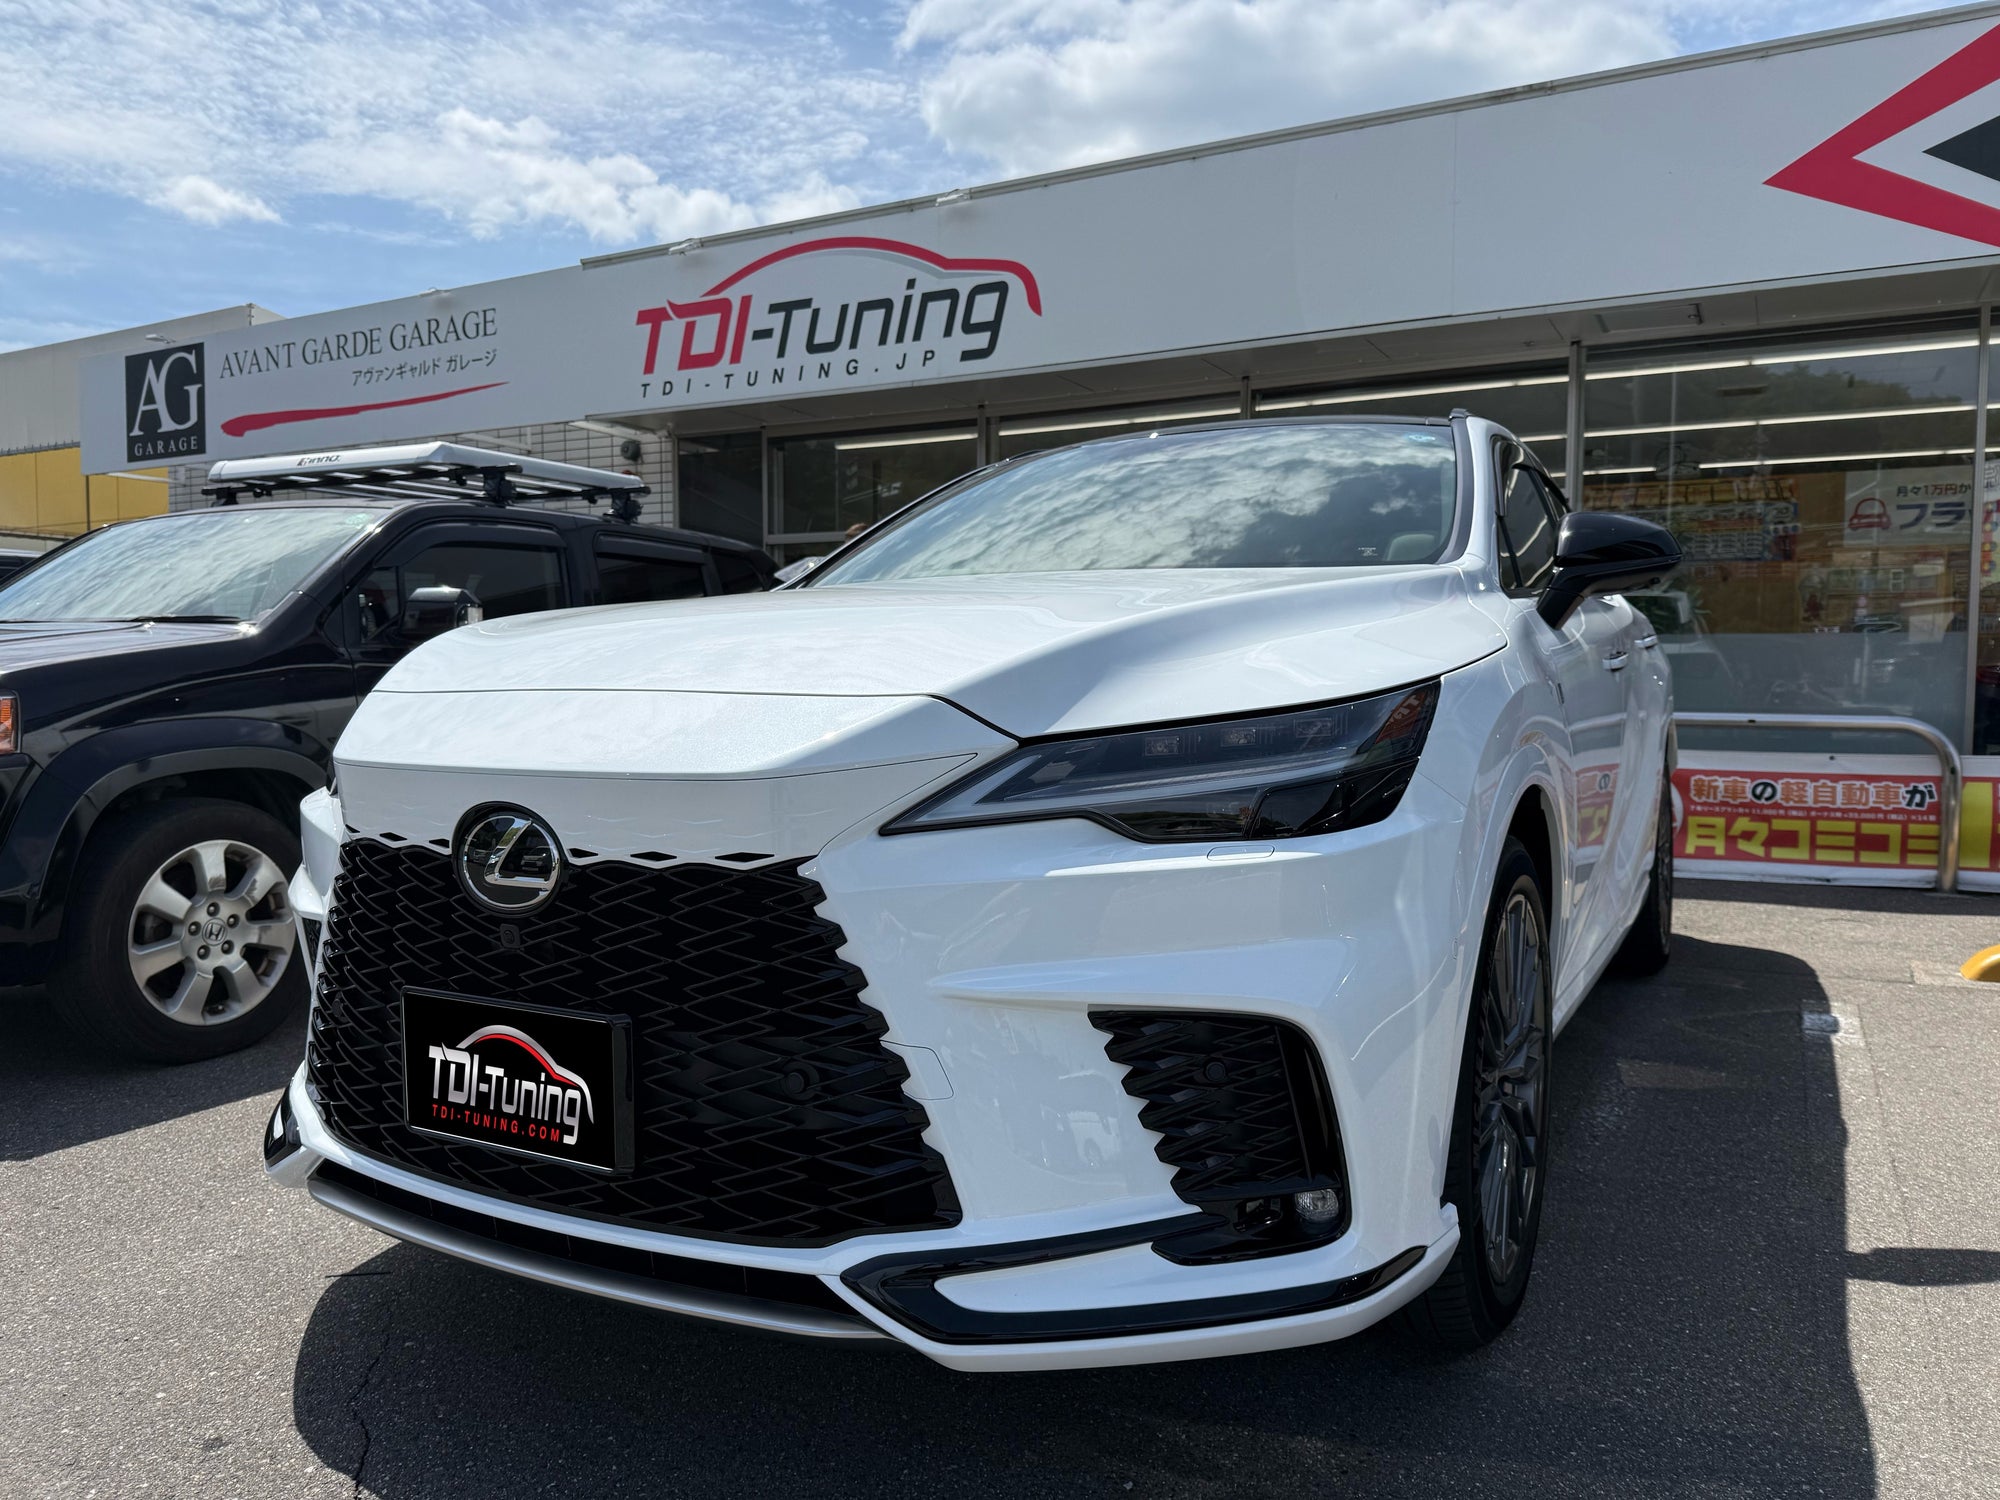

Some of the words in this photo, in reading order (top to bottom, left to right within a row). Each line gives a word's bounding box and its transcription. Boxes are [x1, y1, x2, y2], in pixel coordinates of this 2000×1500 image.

[219, 342, 297, 379] AVANT
[301, 327, 383, 365] GARDE
[389, 307, 499, 351] GARAGE
[636, 278, 1009, 375] TDI-Tuning
[352, 357, 441, 387] アヴァンギャルド
[446, 349, 498, 373] ガレージ
[641, 350, 937, 399] TDI-TUNING.JP
[129, 350, 203, 437] AG
[134, 436, 199, 457] GARAGE
[1690, 774, 1937, 811] 新車の軽自動車が
[428, 1043, 581, 1146] TDI-Tuning
[432, 1104, 560, 1143] TDI-TUNING.COM
